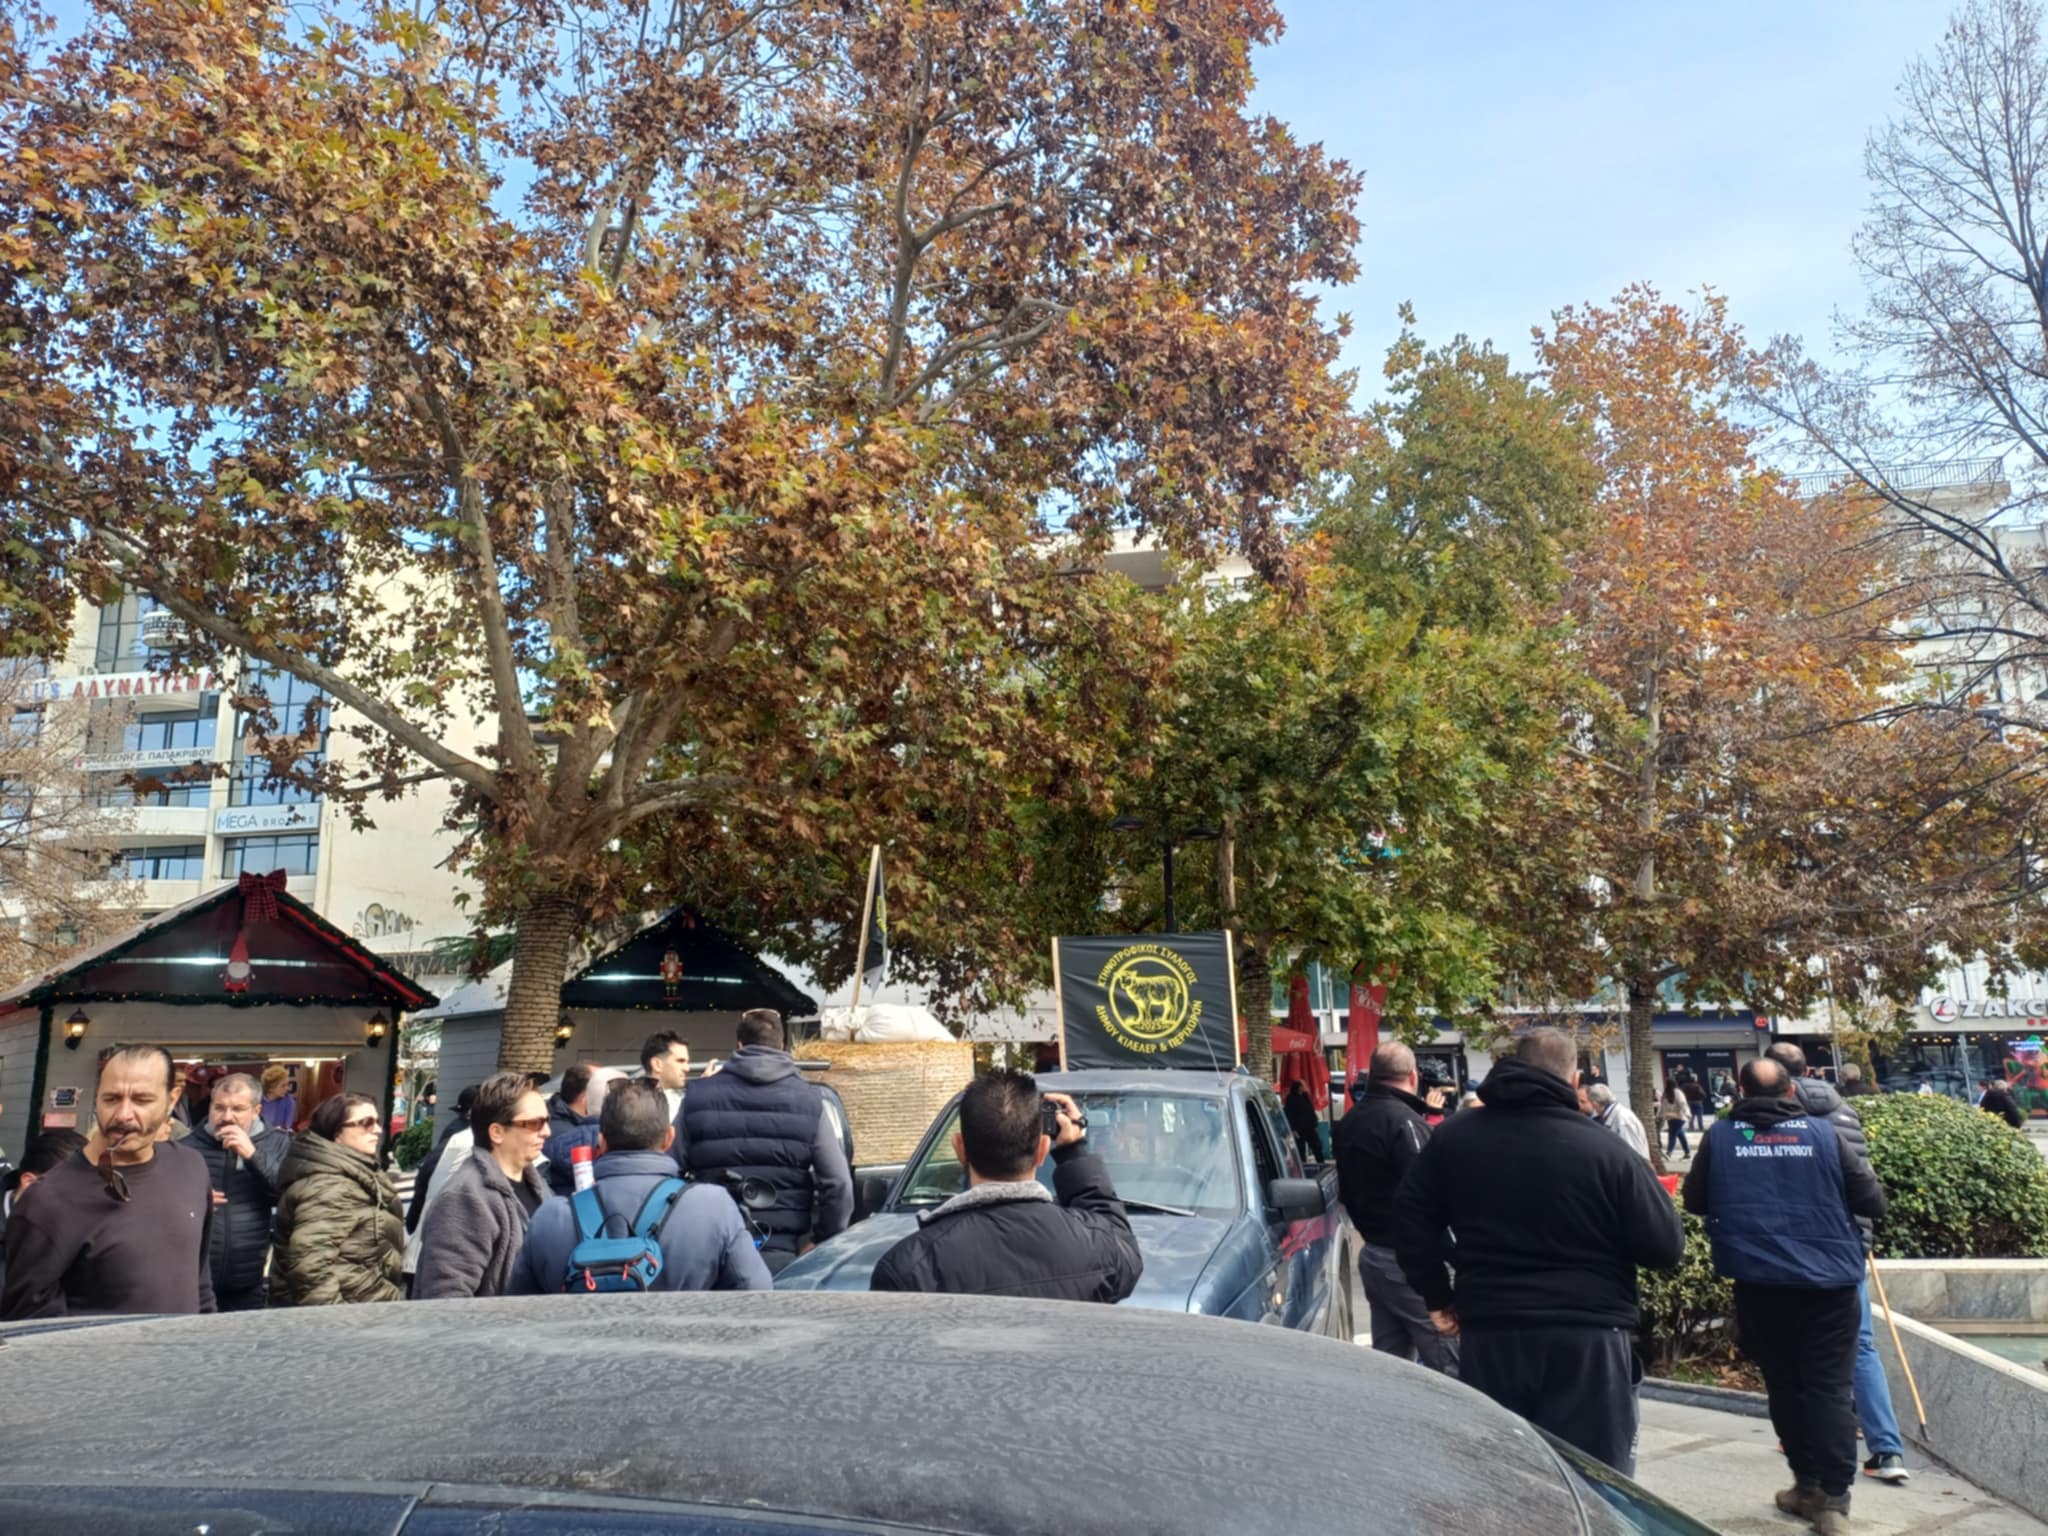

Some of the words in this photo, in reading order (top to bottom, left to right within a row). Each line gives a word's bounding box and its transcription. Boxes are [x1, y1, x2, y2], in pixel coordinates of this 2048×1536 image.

[217, 812, 257, 829] MEGA
[1097, 944, 1158, 987] ΚΤΗΝΟΤΡΟΦΙΚΟΣ
[1160, 947, 1198, 985] ΣΥΛΛΟΓΟΣ
[1096, 1005, 1119, 1037] ΔΗΜΟΥ
[1117, 1034, 1157, 1053] ΚΙΛΕΛΕΡ
[1160, 1042, 1168, 1052] &
[1168, 1000, 1202, 1048] ΠΕΡΙΧΩΡΩΝ
